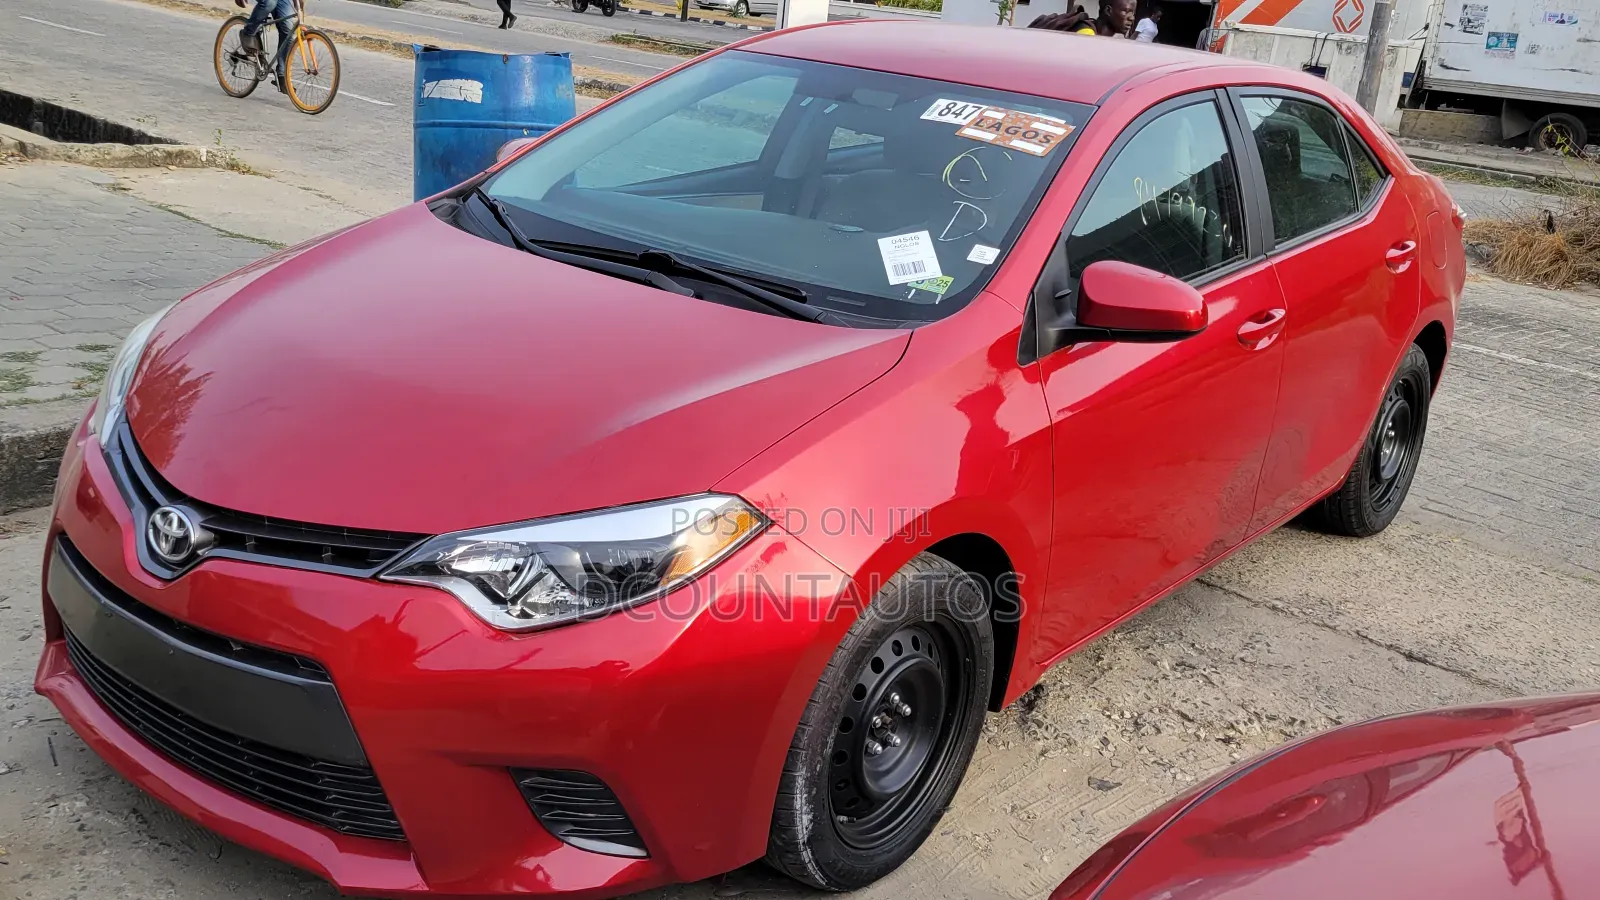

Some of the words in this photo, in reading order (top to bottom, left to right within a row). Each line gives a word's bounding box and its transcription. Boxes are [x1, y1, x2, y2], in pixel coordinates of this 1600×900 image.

[938, 102, 983, 120] 847
[974, 118, 1056, 144] LAGOS
[891, 235, 920, 244] 04546
